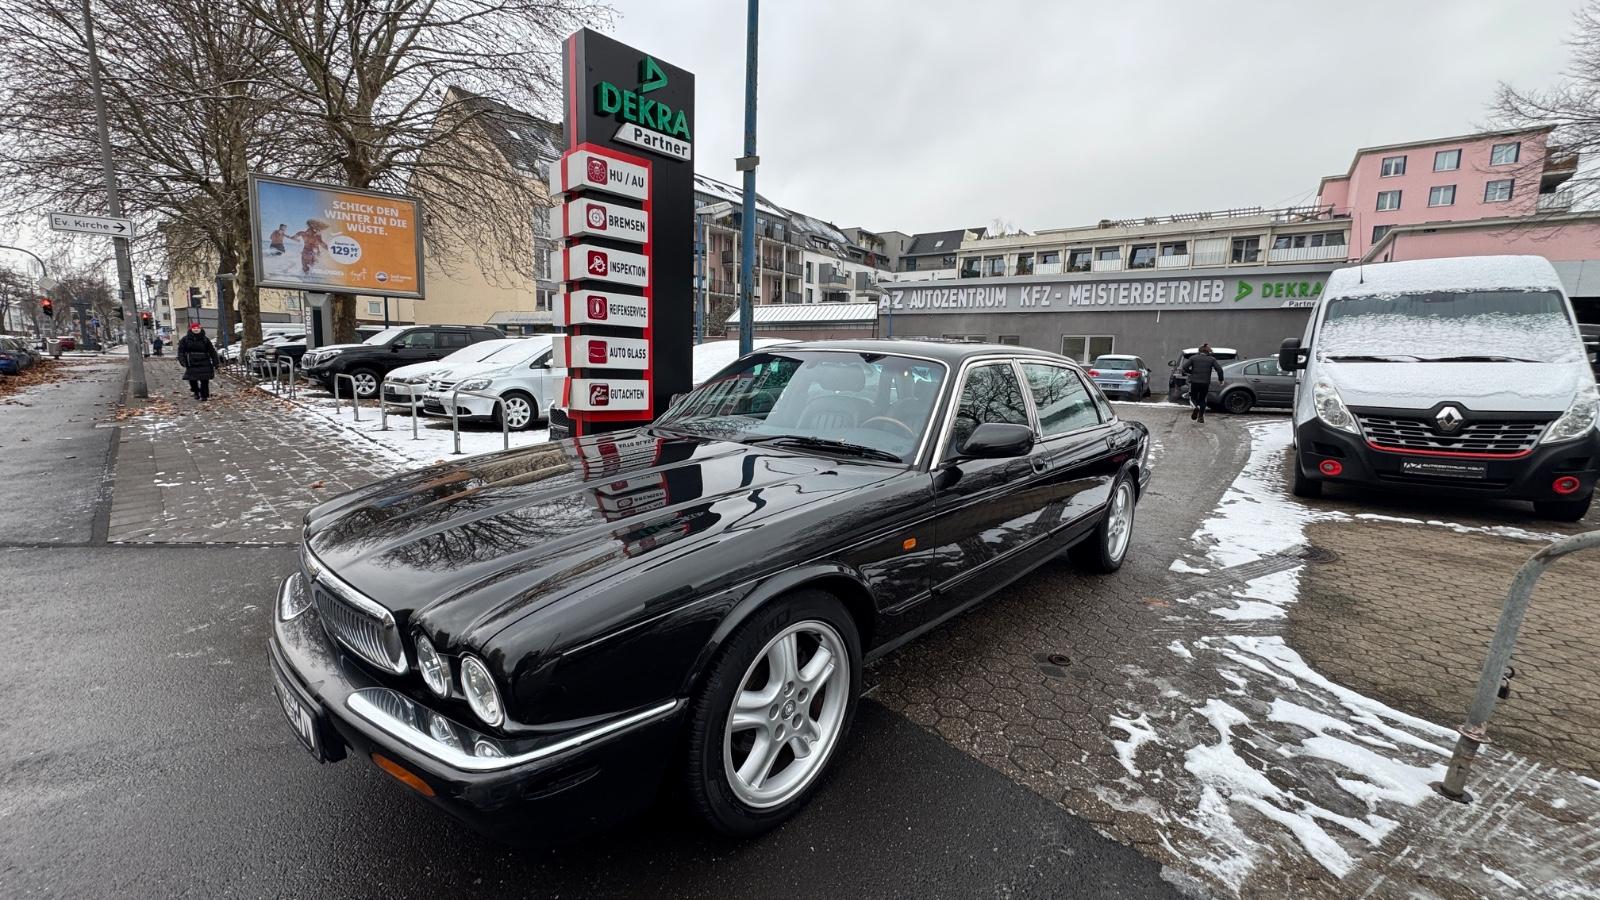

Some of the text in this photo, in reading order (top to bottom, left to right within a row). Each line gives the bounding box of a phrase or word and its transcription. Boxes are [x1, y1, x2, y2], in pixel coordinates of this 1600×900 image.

[601, 81, 691, 140] DEKRA
[634, 127, 688, 156] Partner
[609, 168, 623, 182] HU
[631, 174, 644, 188] AU
[332, 200, 399, 217] SCHICK DEN
[54, 218, 109, 230] Ev. Kirche
[324, 209, 407, 229] WINTER IN DIE
[608, 214, 646, 233] BREMSEN
[346, 222, 388, 236] WÜSTE.
[609, 261, 646, 278] INSPEKTION
[879, 290, 904, 309] AZ
[909, 286, 1007, 309] AUTOZENTRUM
[1020, 285, 1052, 307] KFZ
[1069, 280, 1225, 305] MEISTERBETRIEB
[1261, 281, 1325, 298] DEKRA
[609, 303, 647, 318] REIFENSERVICE
[609, 348, 646, 359] AUTO GLASS
[610, 388, 645, 400] GUTACHTEN
